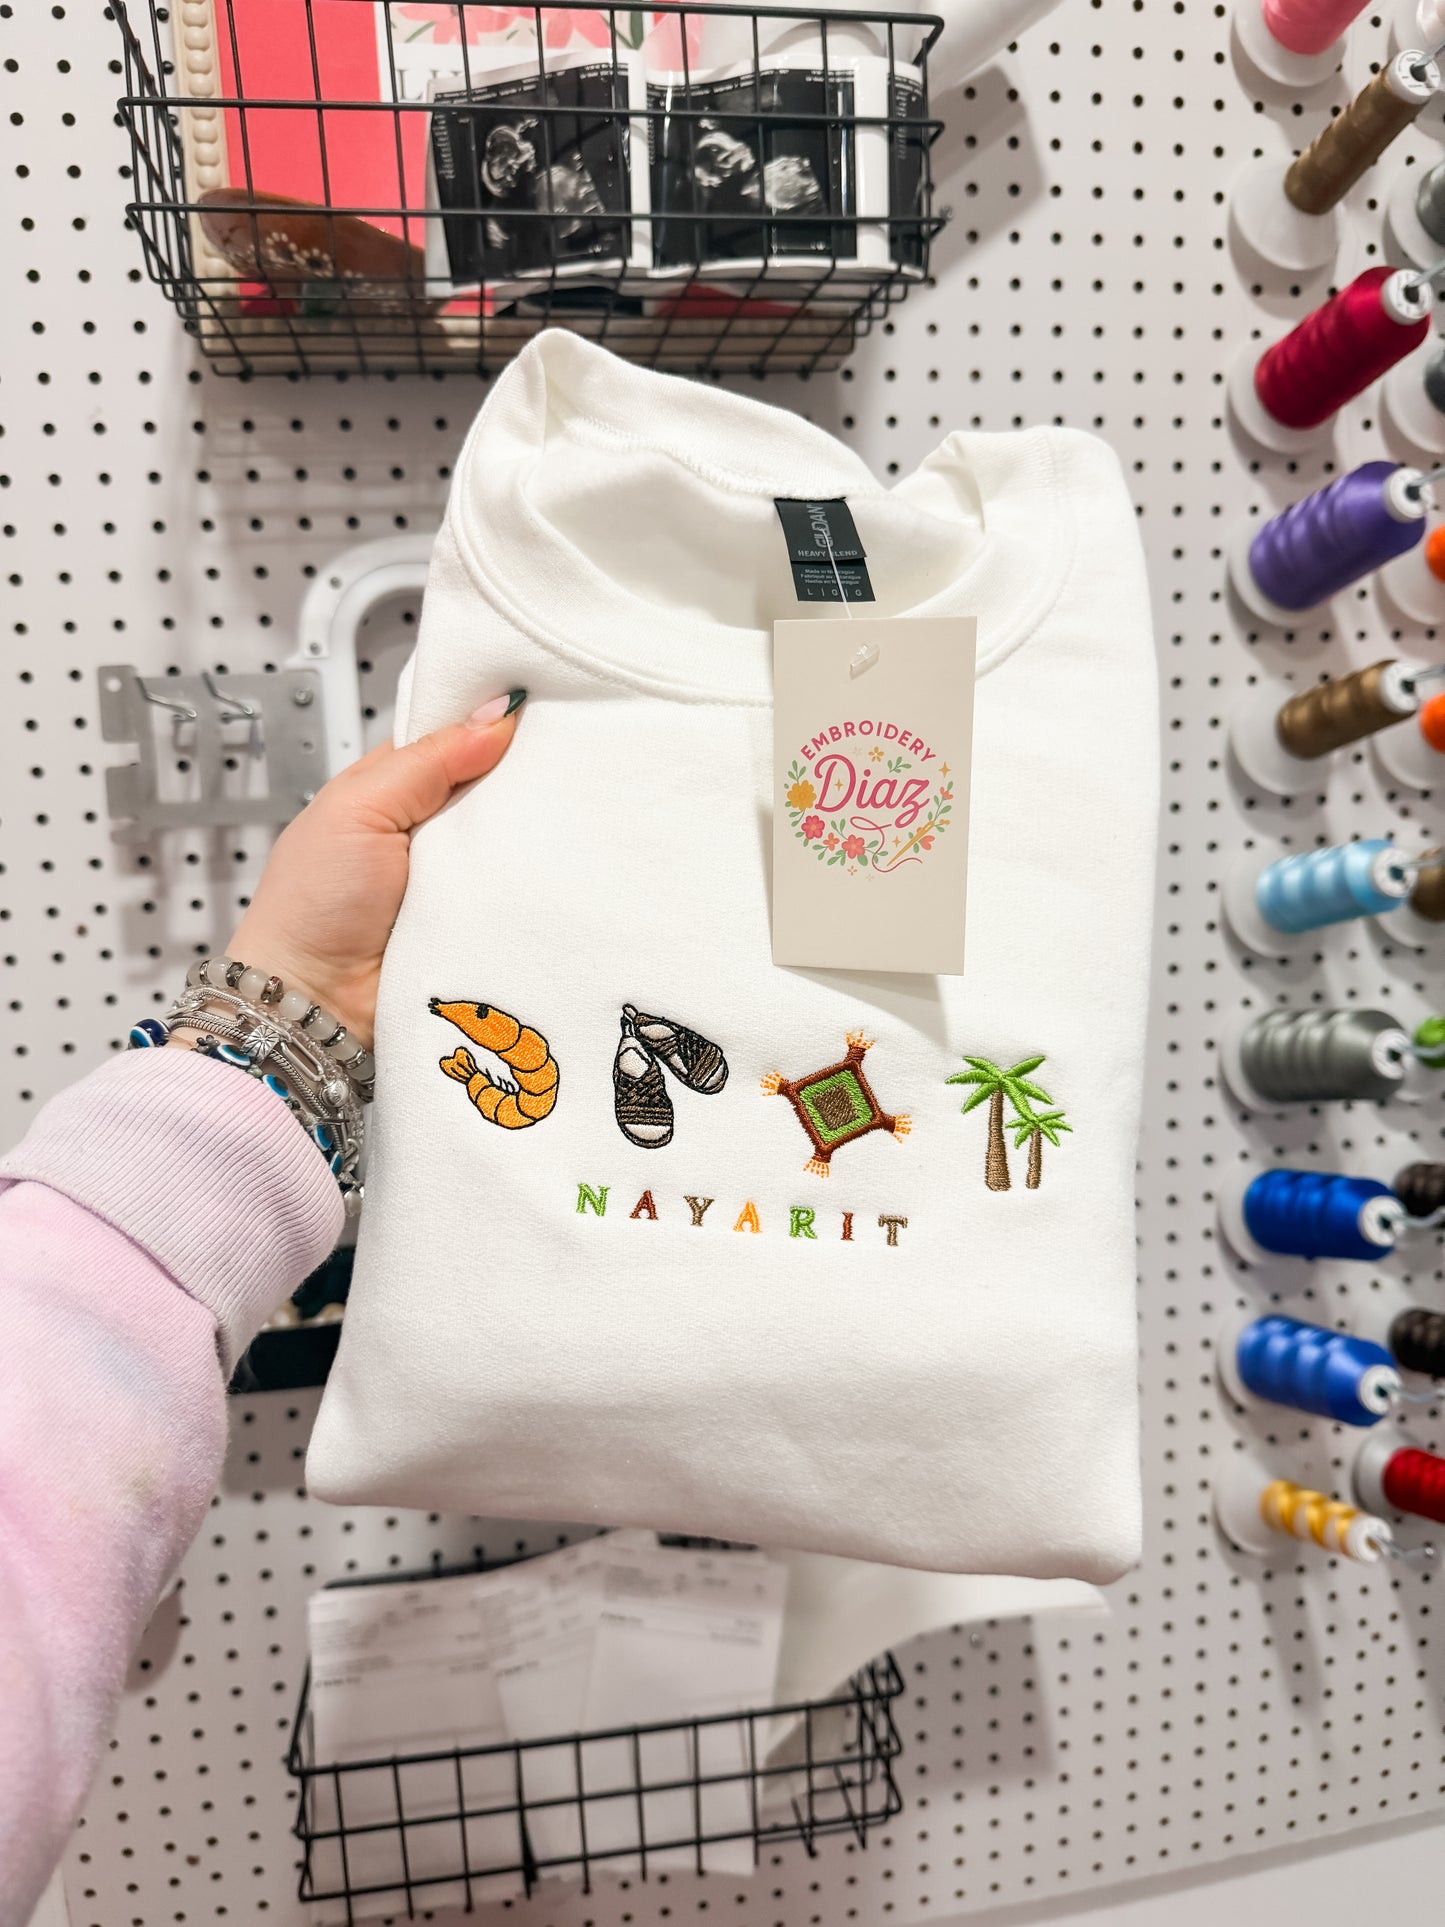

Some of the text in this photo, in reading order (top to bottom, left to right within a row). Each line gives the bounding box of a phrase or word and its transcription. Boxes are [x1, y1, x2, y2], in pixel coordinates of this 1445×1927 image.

[807, 588, 813, 596] L
[855, 589, 862, 597] G
[801, 720, 936, 762] EMBROIDERY
[814, 754, 931, 829] Diaz
[575, 1182, 908, 1247] NAYARIT
